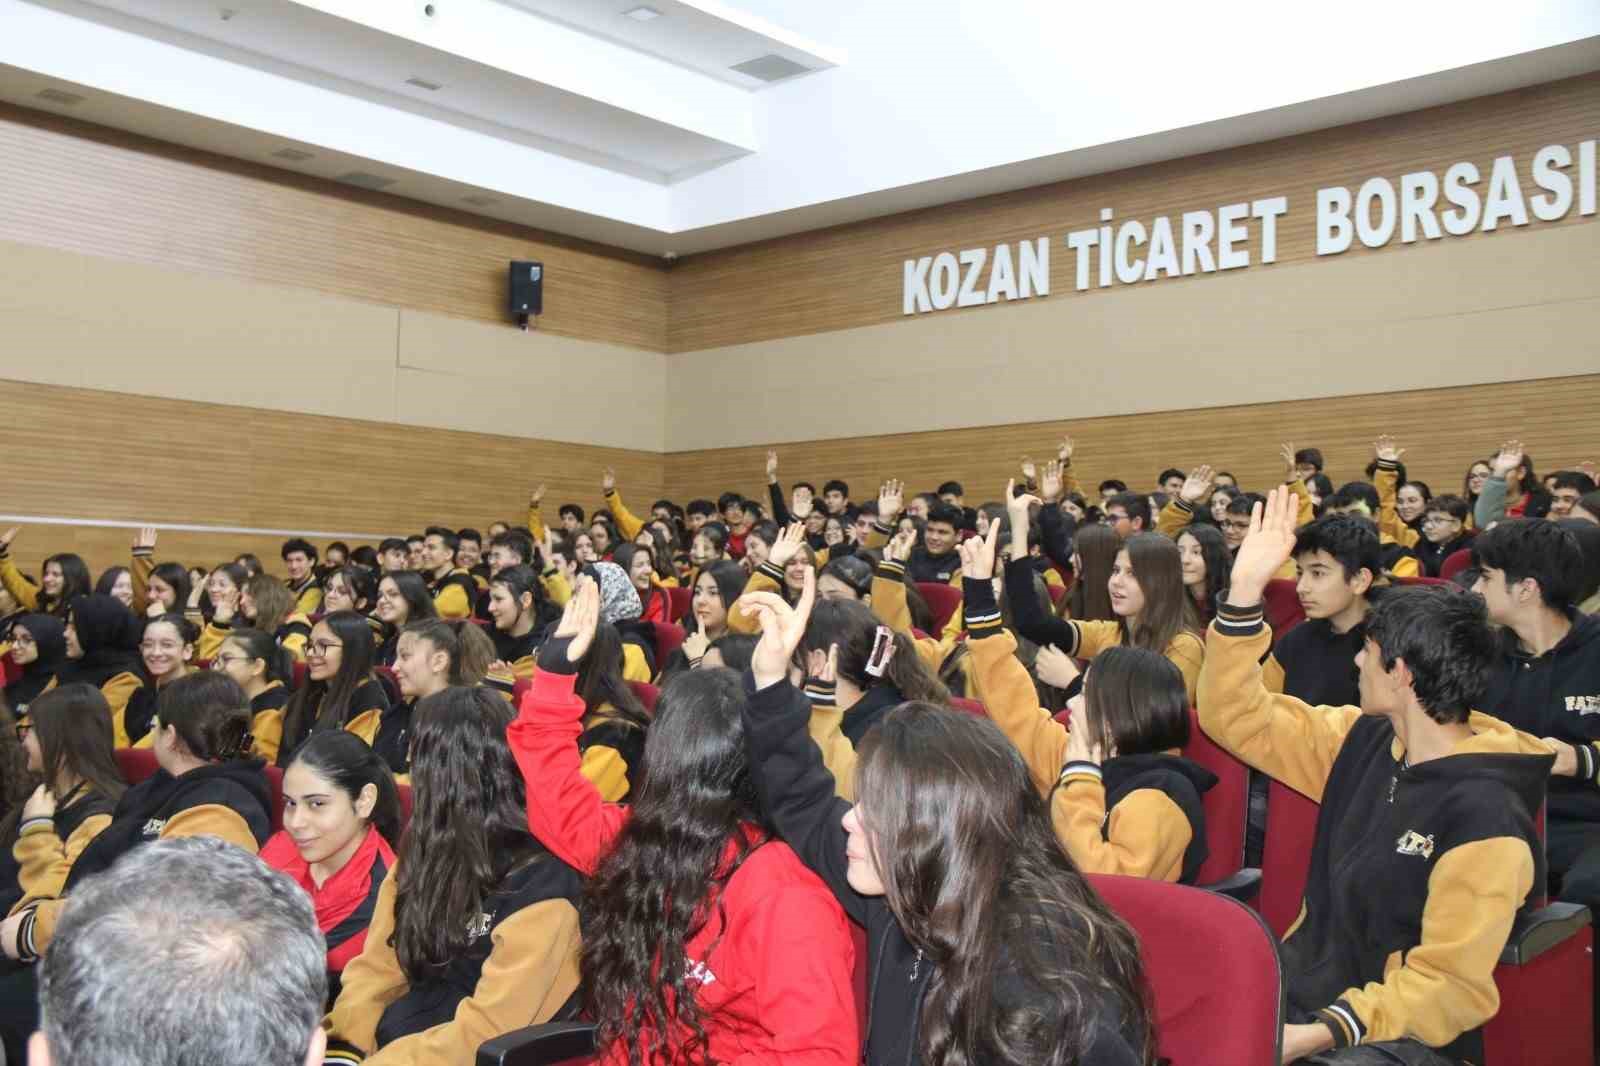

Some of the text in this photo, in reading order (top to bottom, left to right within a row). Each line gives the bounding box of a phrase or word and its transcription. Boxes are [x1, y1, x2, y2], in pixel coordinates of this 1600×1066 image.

[903, 139, 1597, 315] KOZAN TİCARET BORSASI
